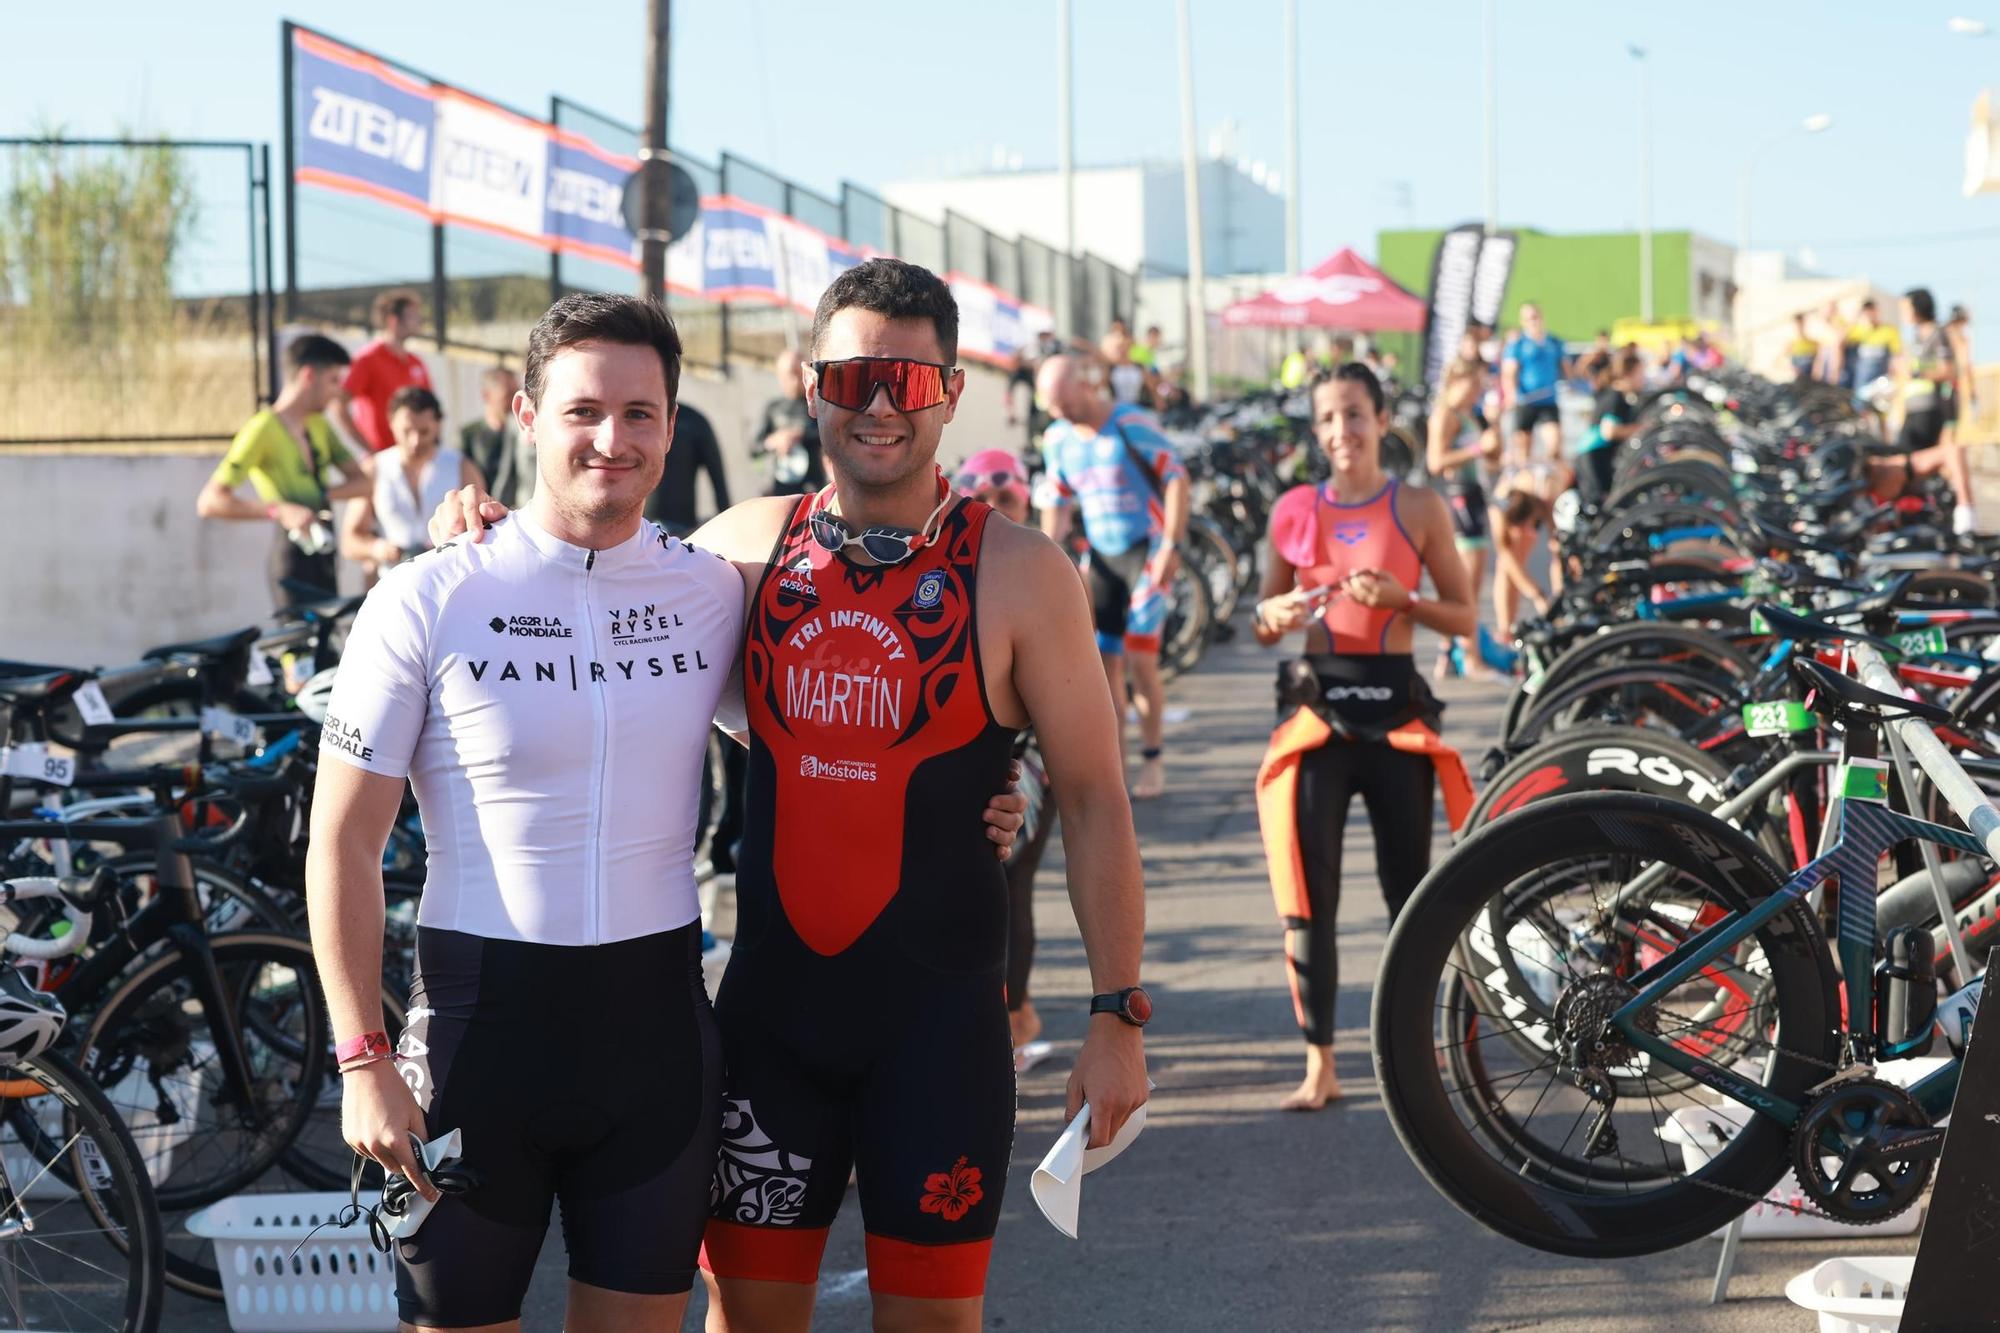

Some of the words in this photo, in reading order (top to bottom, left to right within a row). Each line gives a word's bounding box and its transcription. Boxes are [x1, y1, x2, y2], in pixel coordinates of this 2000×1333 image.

[509, 615, 541, 627] AG2R
[544, 617, 562, 627] LA
[608, 604, 655, 619] VAN
[509, 626, 573, 638] MONDIALE
[611, 614, 683, 635] RYSEL
[653, 634, 670, 643] TEAM
[789, 617, 823, 650] TRI
[830, 610, 906, 661] INFINITY
[1900, 631, 1938, 657] 231
[468, 660, 556, 682] VAN
[590, 650, 709, 682] RYSEL
[786, 665, 902, 730] MARTÍN
[1750, 705, 1789, 730] 232
[342, 722, 362, 742] LA
[322, 728, 373, 762] NDIALE
[44, 758, 68, 779] 95
[818, 761, 877, 781] Móstoles
